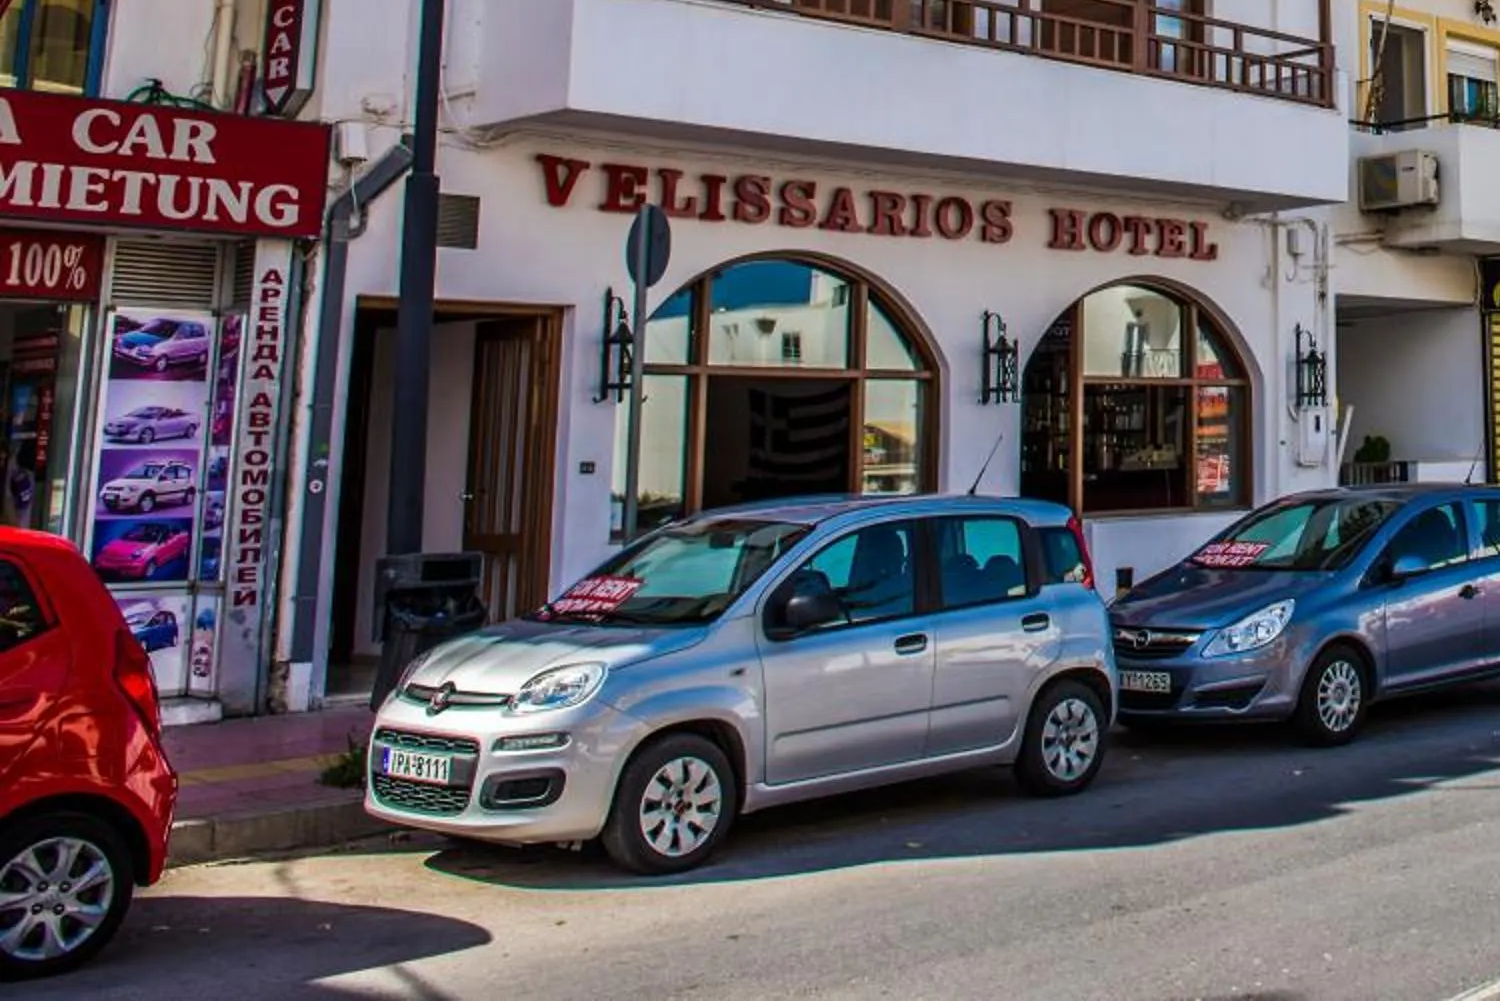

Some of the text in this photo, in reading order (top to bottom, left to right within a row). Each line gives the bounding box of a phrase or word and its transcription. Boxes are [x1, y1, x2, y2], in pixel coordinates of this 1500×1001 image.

[268, 6, 294, 79] CAR
[71, 108, 217, 165] CAR
[538, 154, 1219, 262] VELISSARIOS HOTEL
[6, 241, 87, 291] 100%
[233, 268, 283, 607] АРЕНДА АВТОМОБИЛЕЙ
